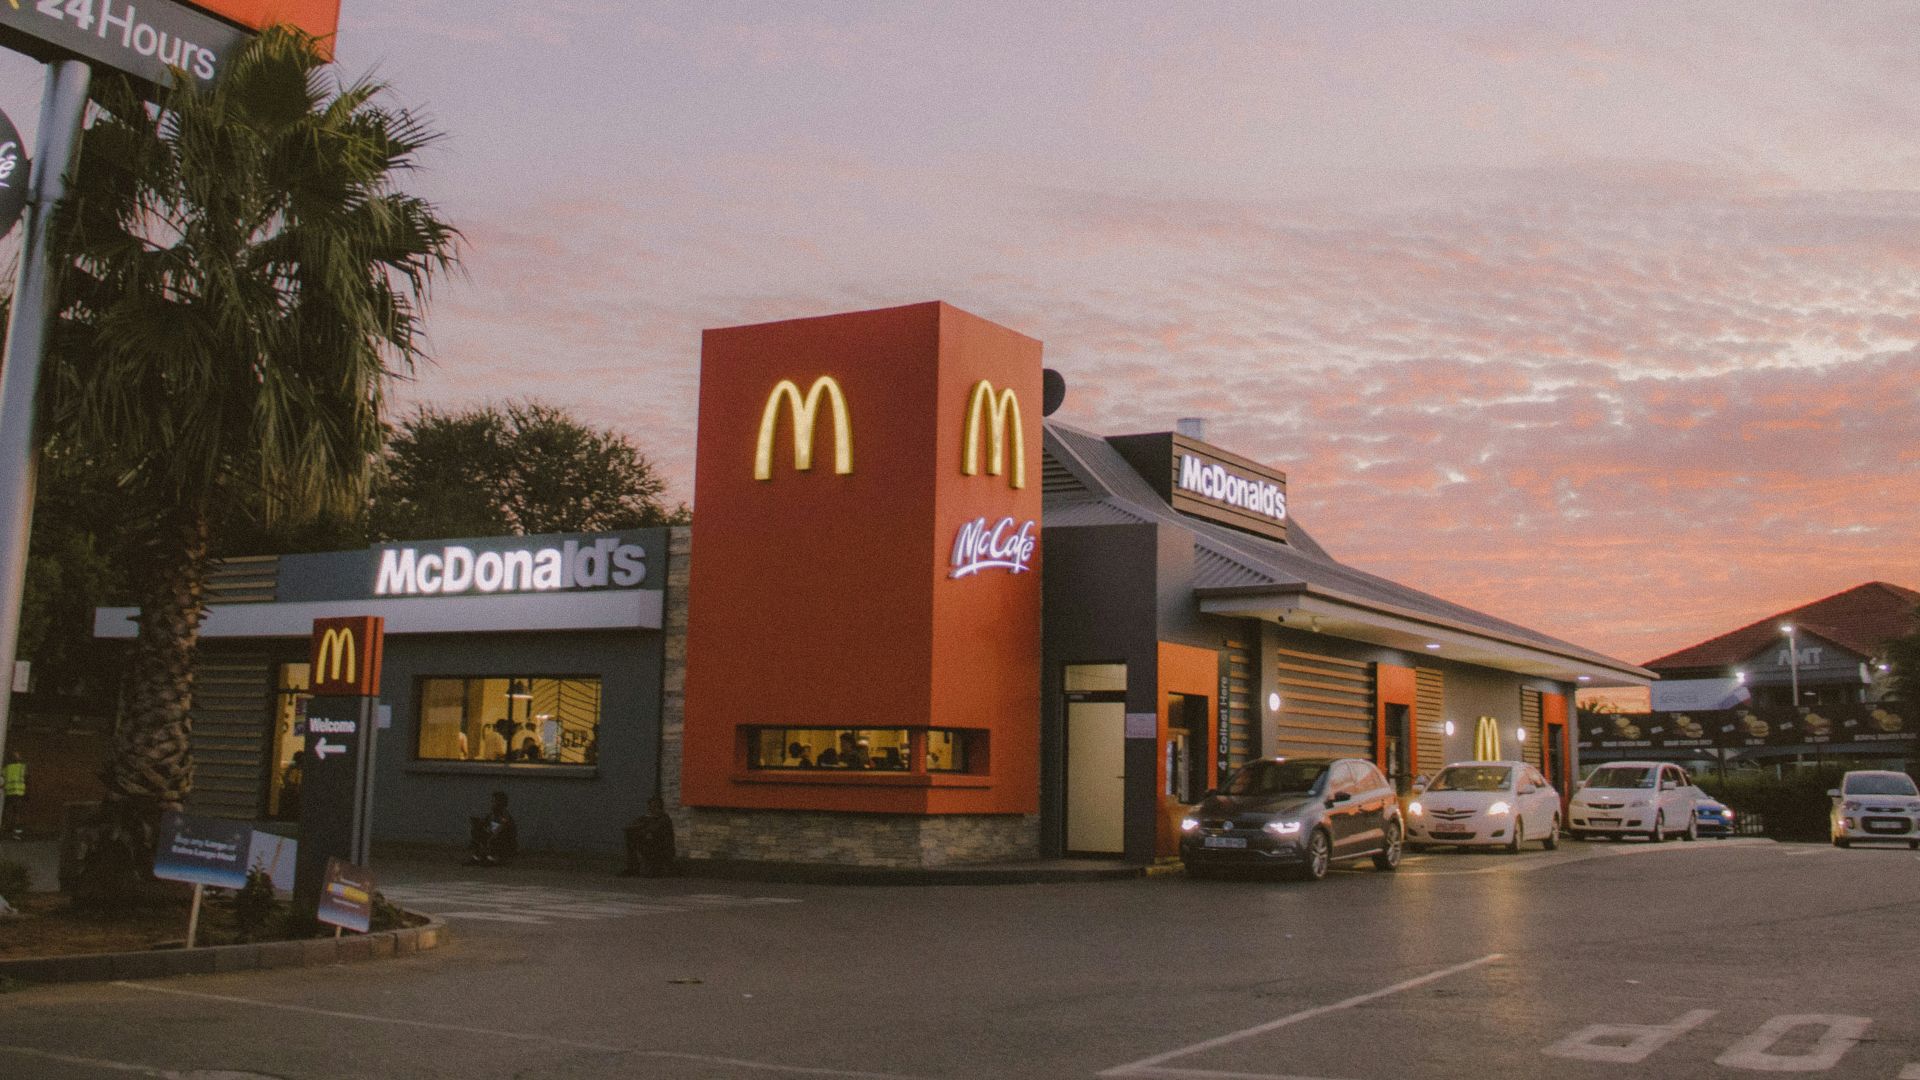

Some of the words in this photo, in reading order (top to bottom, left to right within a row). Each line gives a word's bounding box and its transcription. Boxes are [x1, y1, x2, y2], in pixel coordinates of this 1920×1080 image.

[1179, 454, 1286, 519] McDonald's
[374, 538, 647, 594] McDonald's
[951, 517, 1036, 576] McCafé
[1220, 676, 1228, 705] Here
[309, 717, 356, 733] Welcome
[1219, 708, 1228, 754] Collect
[1218, 761, 1228, 771] 4
